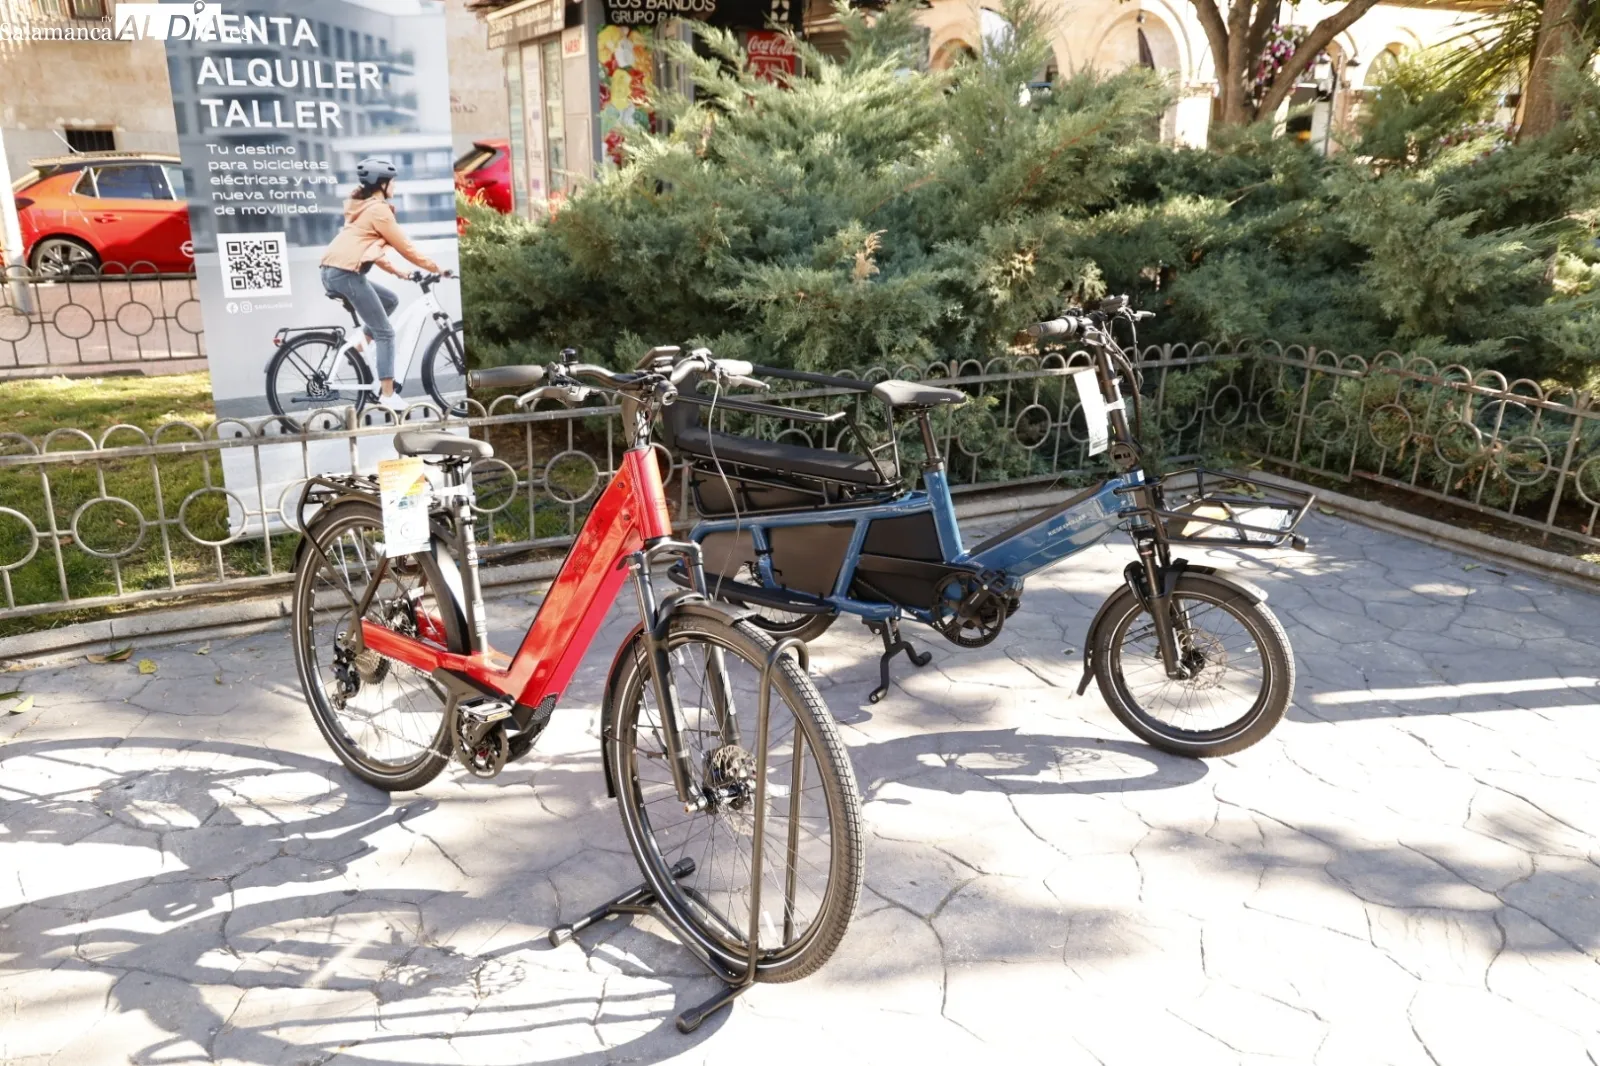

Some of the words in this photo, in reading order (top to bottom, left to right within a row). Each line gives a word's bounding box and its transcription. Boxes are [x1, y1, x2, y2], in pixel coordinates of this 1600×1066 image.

[608, 0, 641, 8] LOS
[646, 0, 716, 11] BANDOS
[611, 10, 655, 23] GRUPO
[194, 13, 319, 48] ENTA
[197, 56, 382, 90] ALQUILER
[200, 99, 343, 129] TALLER
[206, 144, 229, 155] Tu
[234, 144, 296, 155] destino
[208, 160, 248, 172] para
[253, 160, 330, 170] bicicletas
[209, 174, 289, 186] eléctricas
[293, 176, 303, 187] y
[308, 175, 338, 185] una
[211, 190, 264, 200] nueva
[269, 189, 316, 200] forma
[213, 204, 236, 216] de
[241, 203, 322, 215] movilidad.
